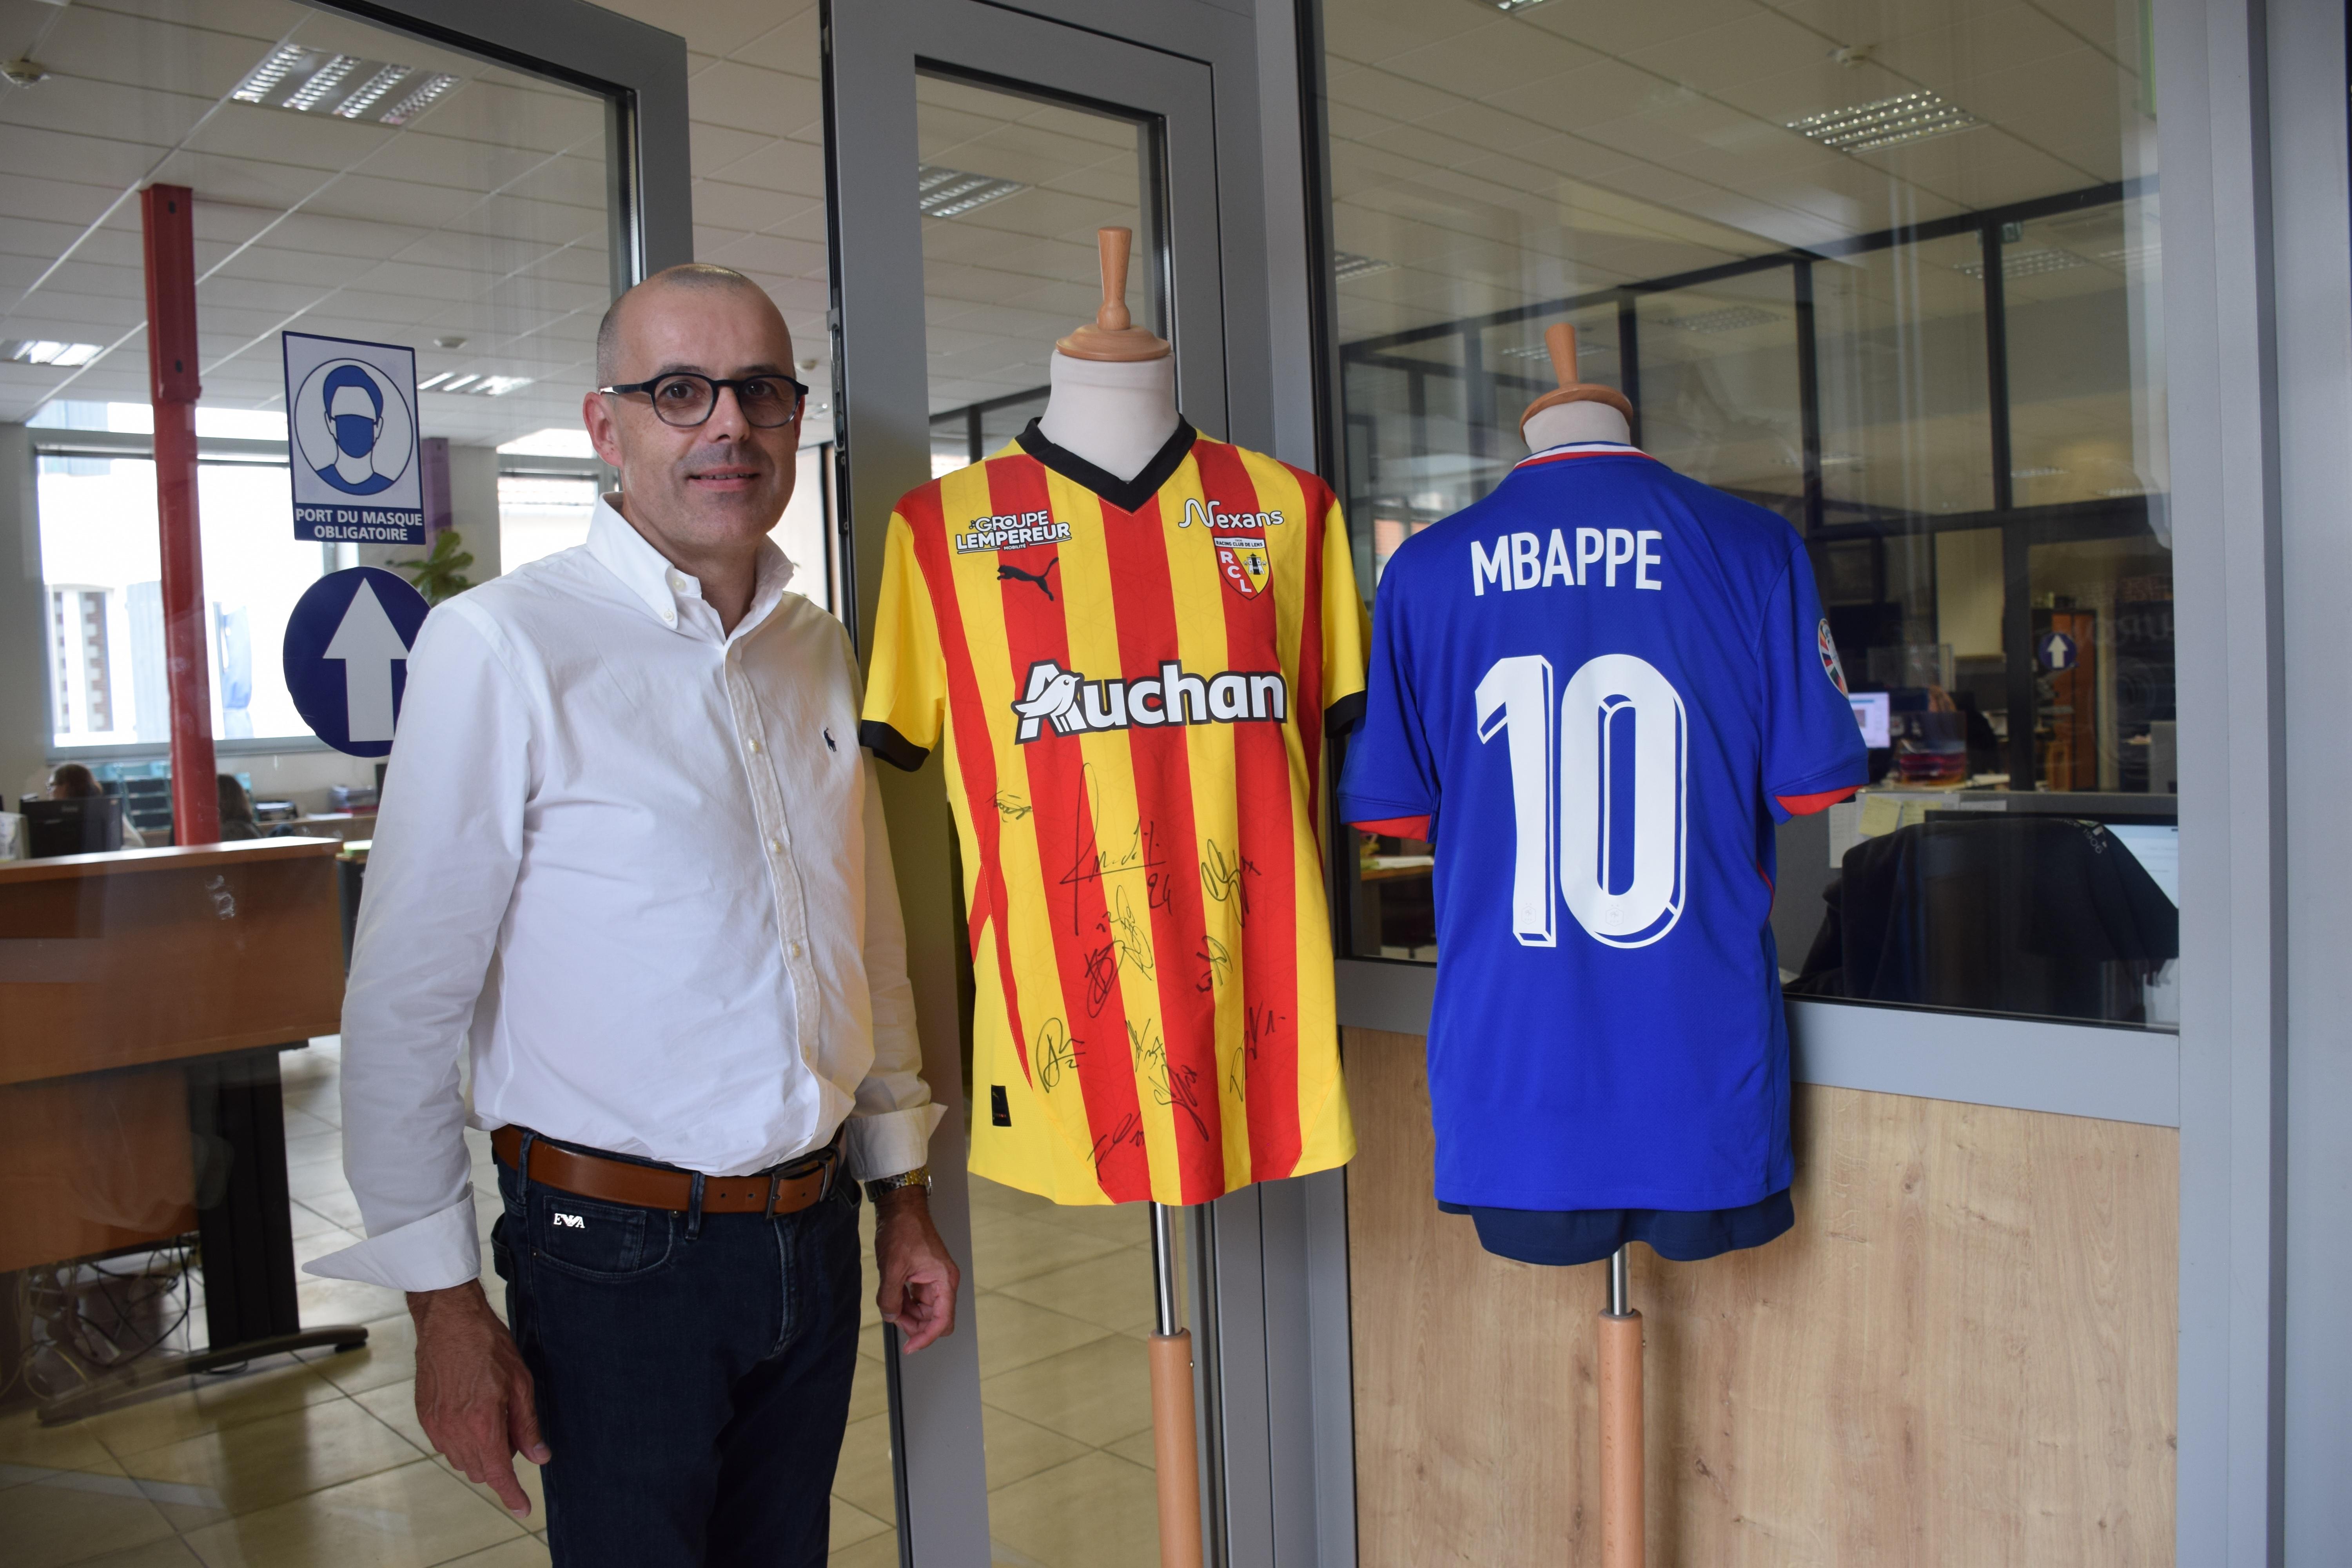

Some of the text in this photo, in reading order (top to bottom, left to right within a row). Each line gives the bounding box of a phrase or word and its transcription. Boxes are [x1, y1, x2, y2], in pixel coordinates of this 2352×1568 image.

[296, 508, 423, 527] PORT DU MASQUE
[975, 510, 1049, 532] GROUPE
[1178, 499, 1283, 528] Nexans
[314, 525, 408, 541] OBLIGATOIRE
[956, 523, 1071, 550] LEMPEREUR
[1470, 528, 1662, 596] MBAPPE
[1016, 659, 1284, 740] Auchan
[1474, 653, 1687, 949] 10
